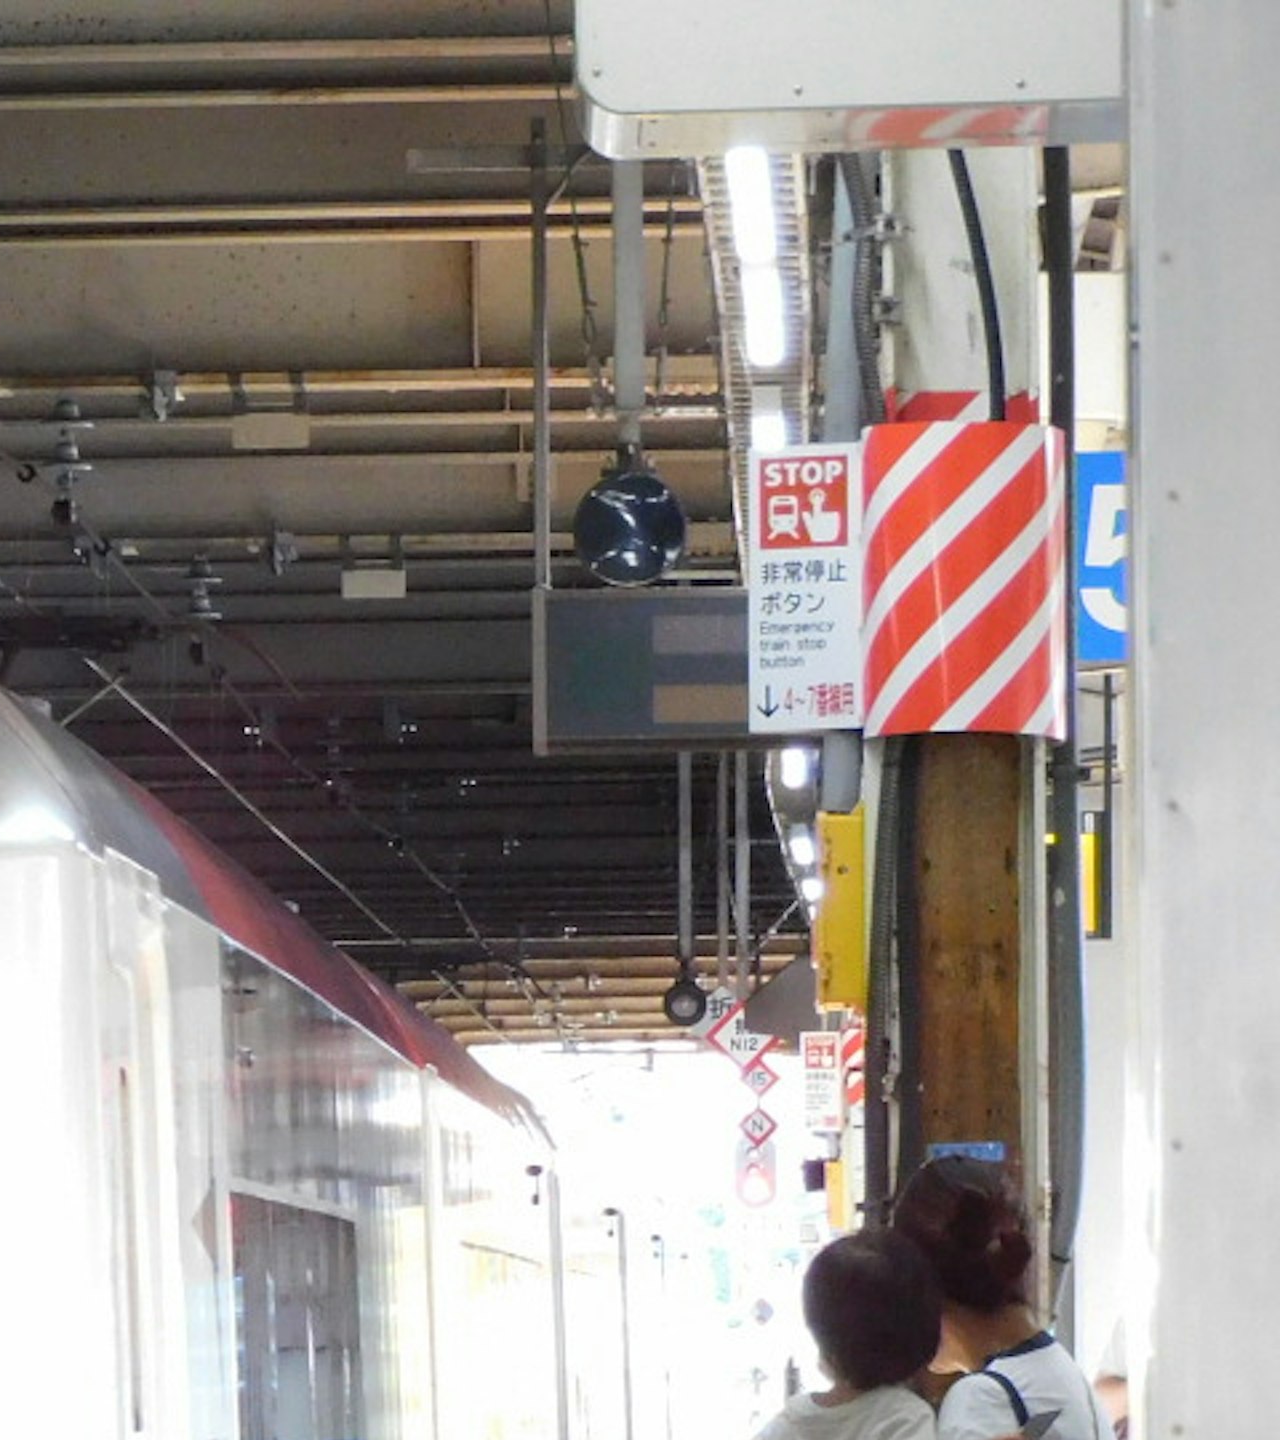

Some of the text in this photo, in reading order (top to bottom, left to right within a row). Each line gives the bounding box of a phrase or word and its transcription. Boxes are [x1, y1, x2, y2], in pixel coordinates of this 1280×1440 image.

[765, 461, 842, 486] STOP
[1080, 484, 1126, 633] 5
[761, 559, 846, 583] 非常停止
[760, 592, 825, 615] ボタン
[760, 620, 834, 636] Emergency
[760, 638, 827, 652] train stop
[760, 657, 805, 670] button
[730, 1037, 758, 1051] N12
[751, 1118, 764, 1133] N
